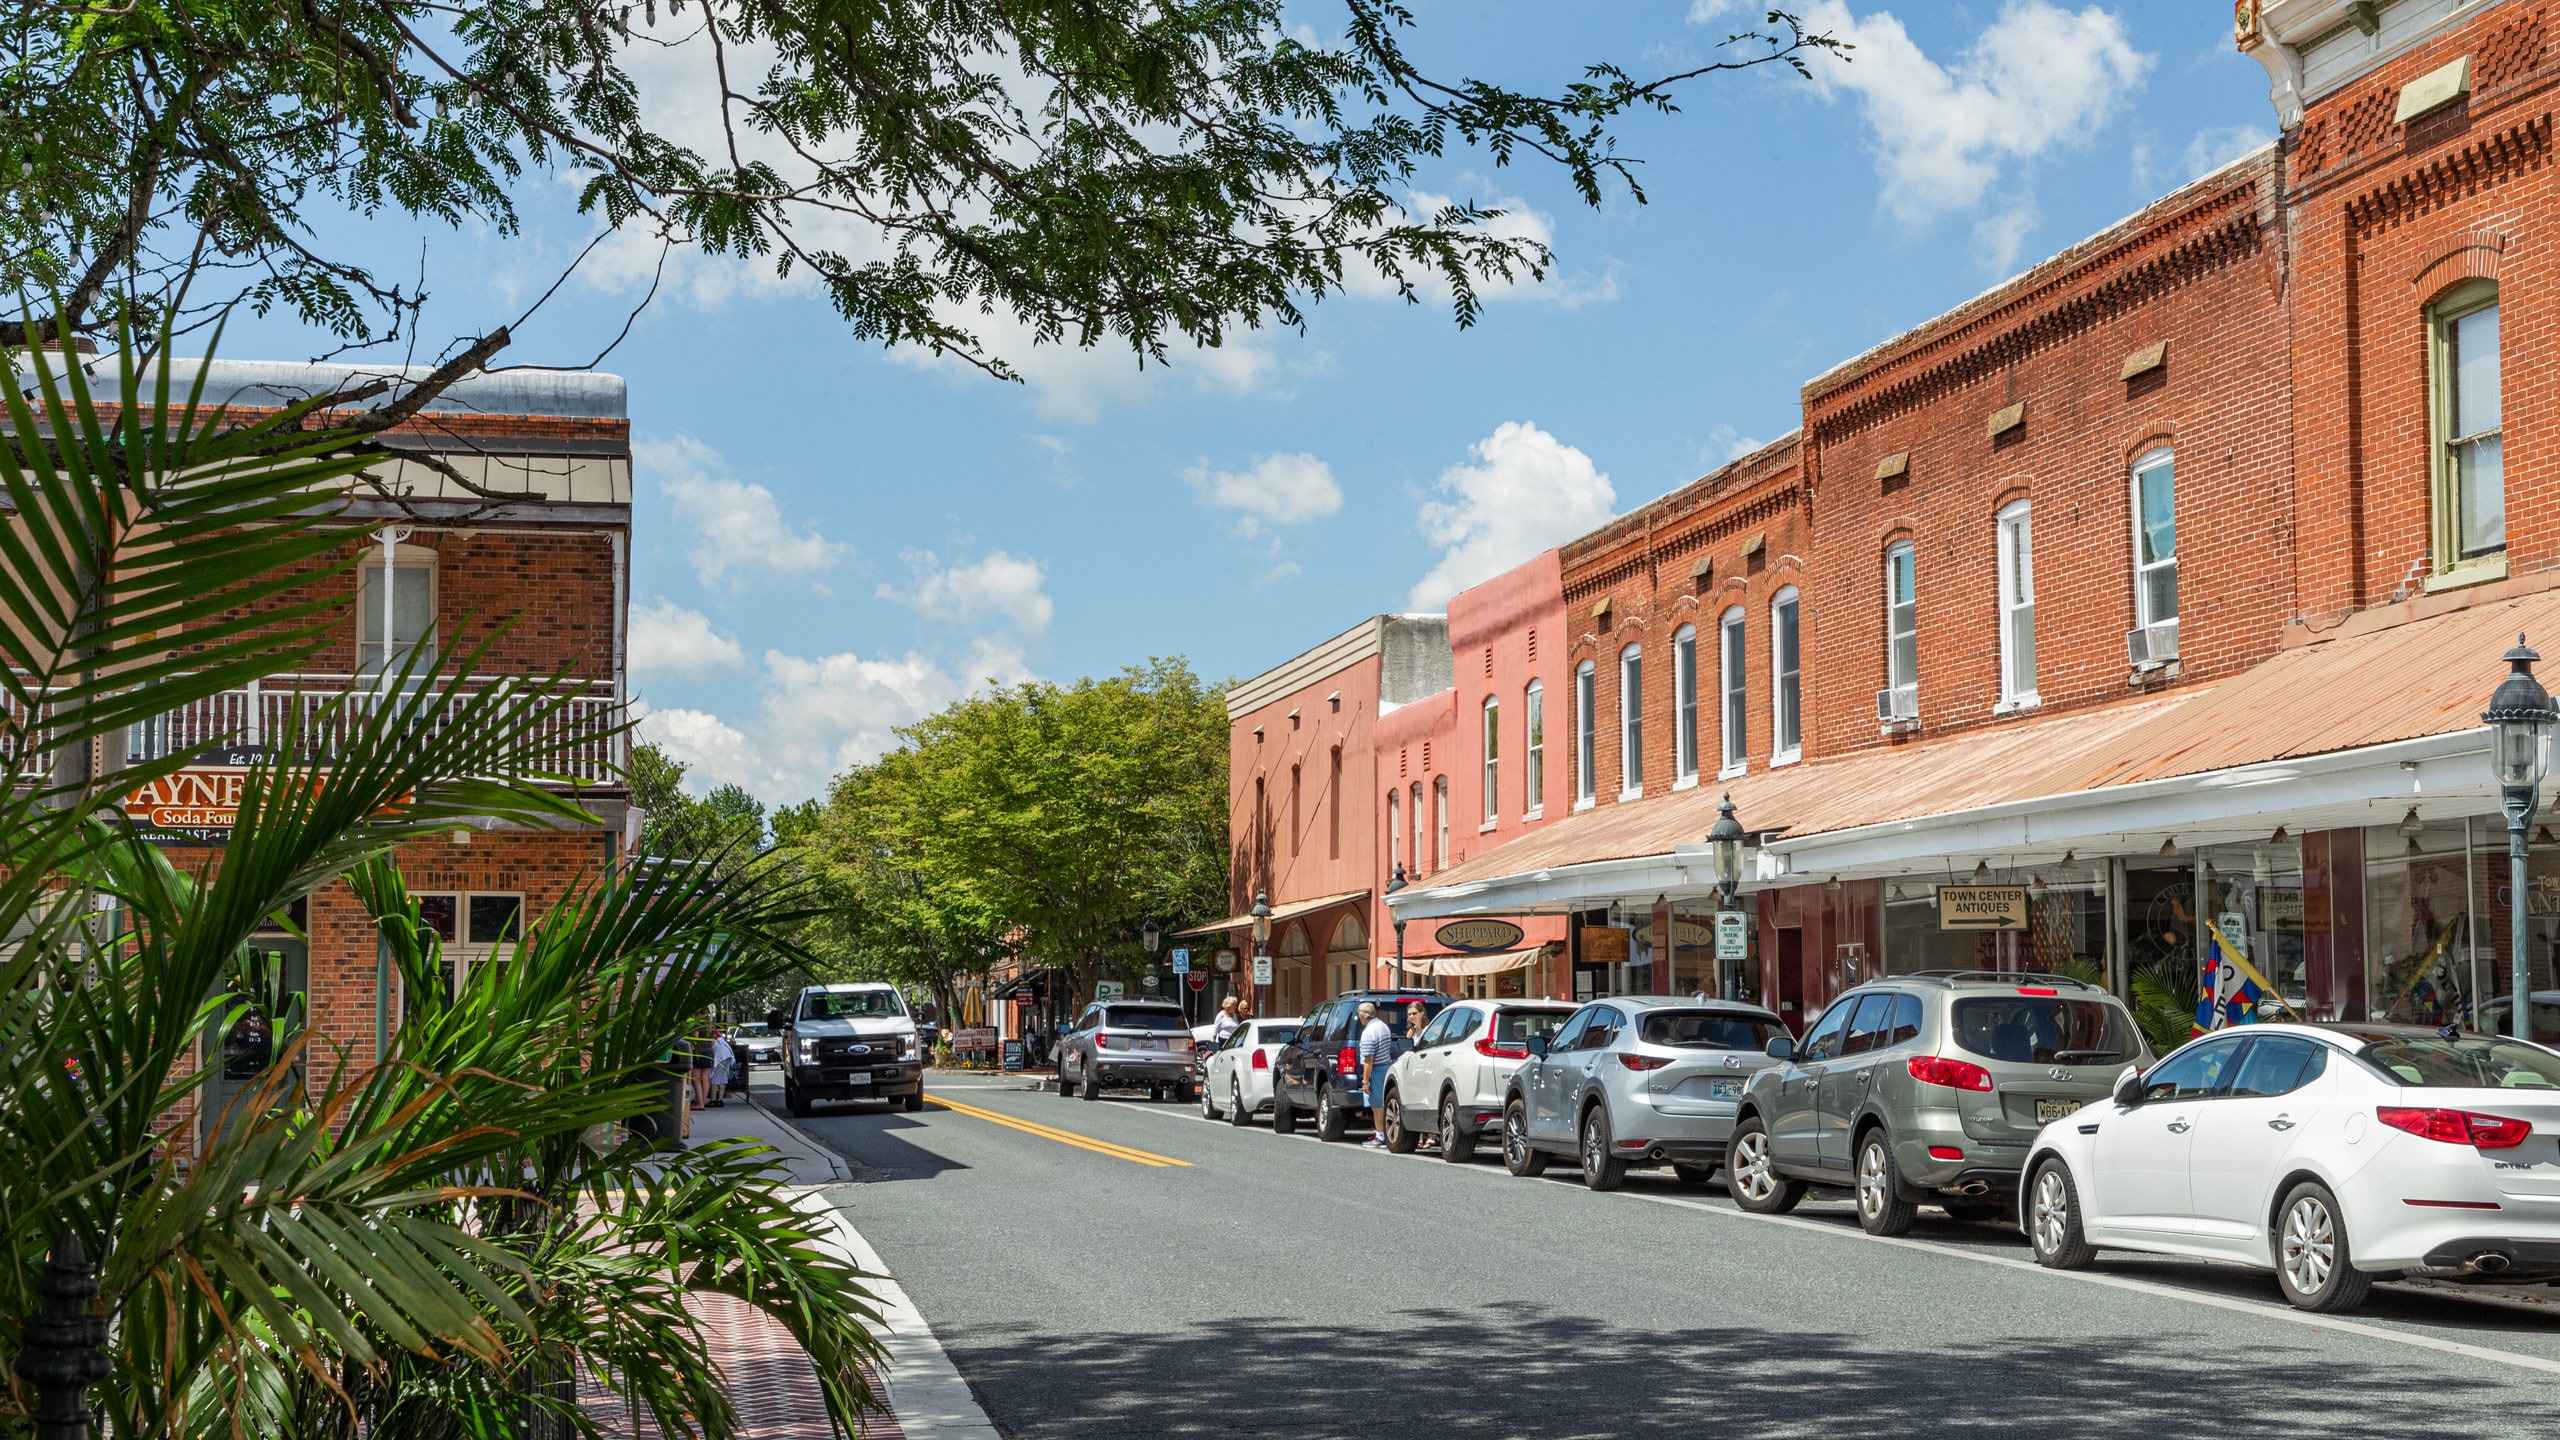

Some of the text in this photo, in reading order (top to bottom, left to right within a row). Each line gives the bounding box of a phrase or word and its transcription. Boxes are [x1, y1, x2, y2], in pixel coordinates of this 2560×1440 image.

[229, 753, 275, 765] Est. 191
[163, 810, 201, 826] Soda
[1943, 890, 2022, 902] TOWN CENTER
[1955, 902, 2010, 914] ANTIQUES
[1446, 927, 1512, 943] SHEPPARD
[1188, 970, 1208, 983] STOP
